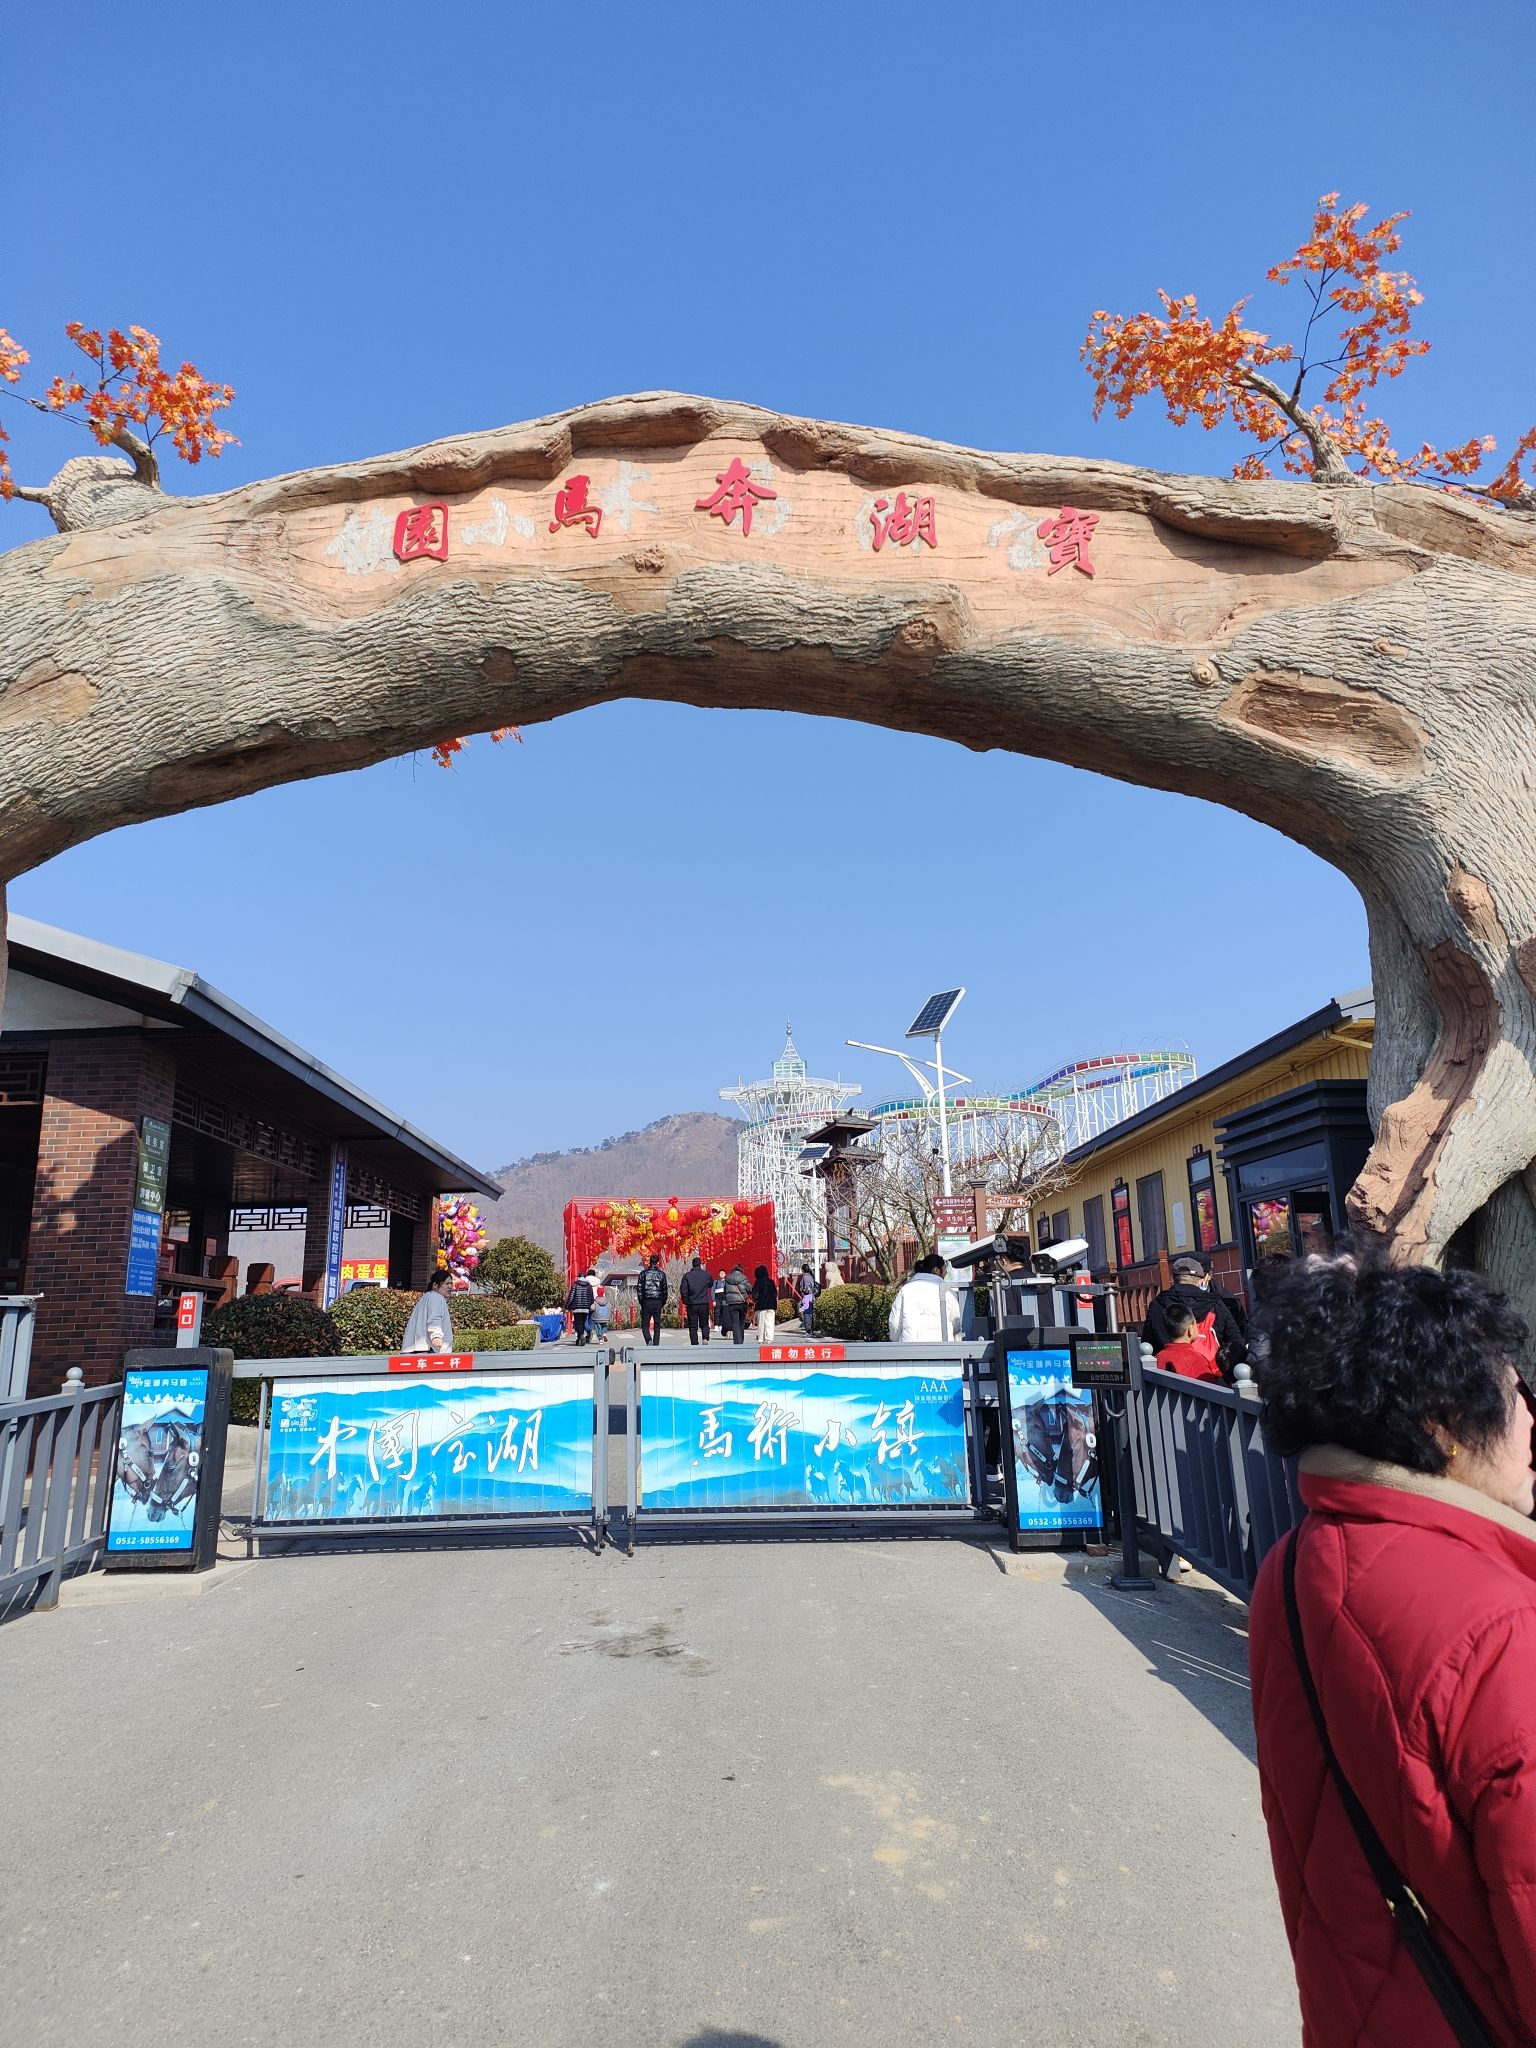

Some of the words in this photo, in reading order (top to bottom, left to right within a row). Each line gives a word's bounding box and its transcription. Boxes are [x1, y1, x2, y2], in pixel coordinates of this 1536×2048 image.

[142, 1161, 163, 1178] 保卫室
[139, 1187, 161, 1203] 游客中心
[181, 1298, 194, 1325] 出口
[771, 1347, 833, 1361] 请勿抢行
[399, 1356, 462, 1370] 一车一杆
[143, 1378, 188, 1388] 宝湖奔马园
[919, 1379, 948, 1393] AAA
[1028, 1517, 1093, 1526] 0532-58556369
[115, 1536, 180, 1545] 0532-58556369
